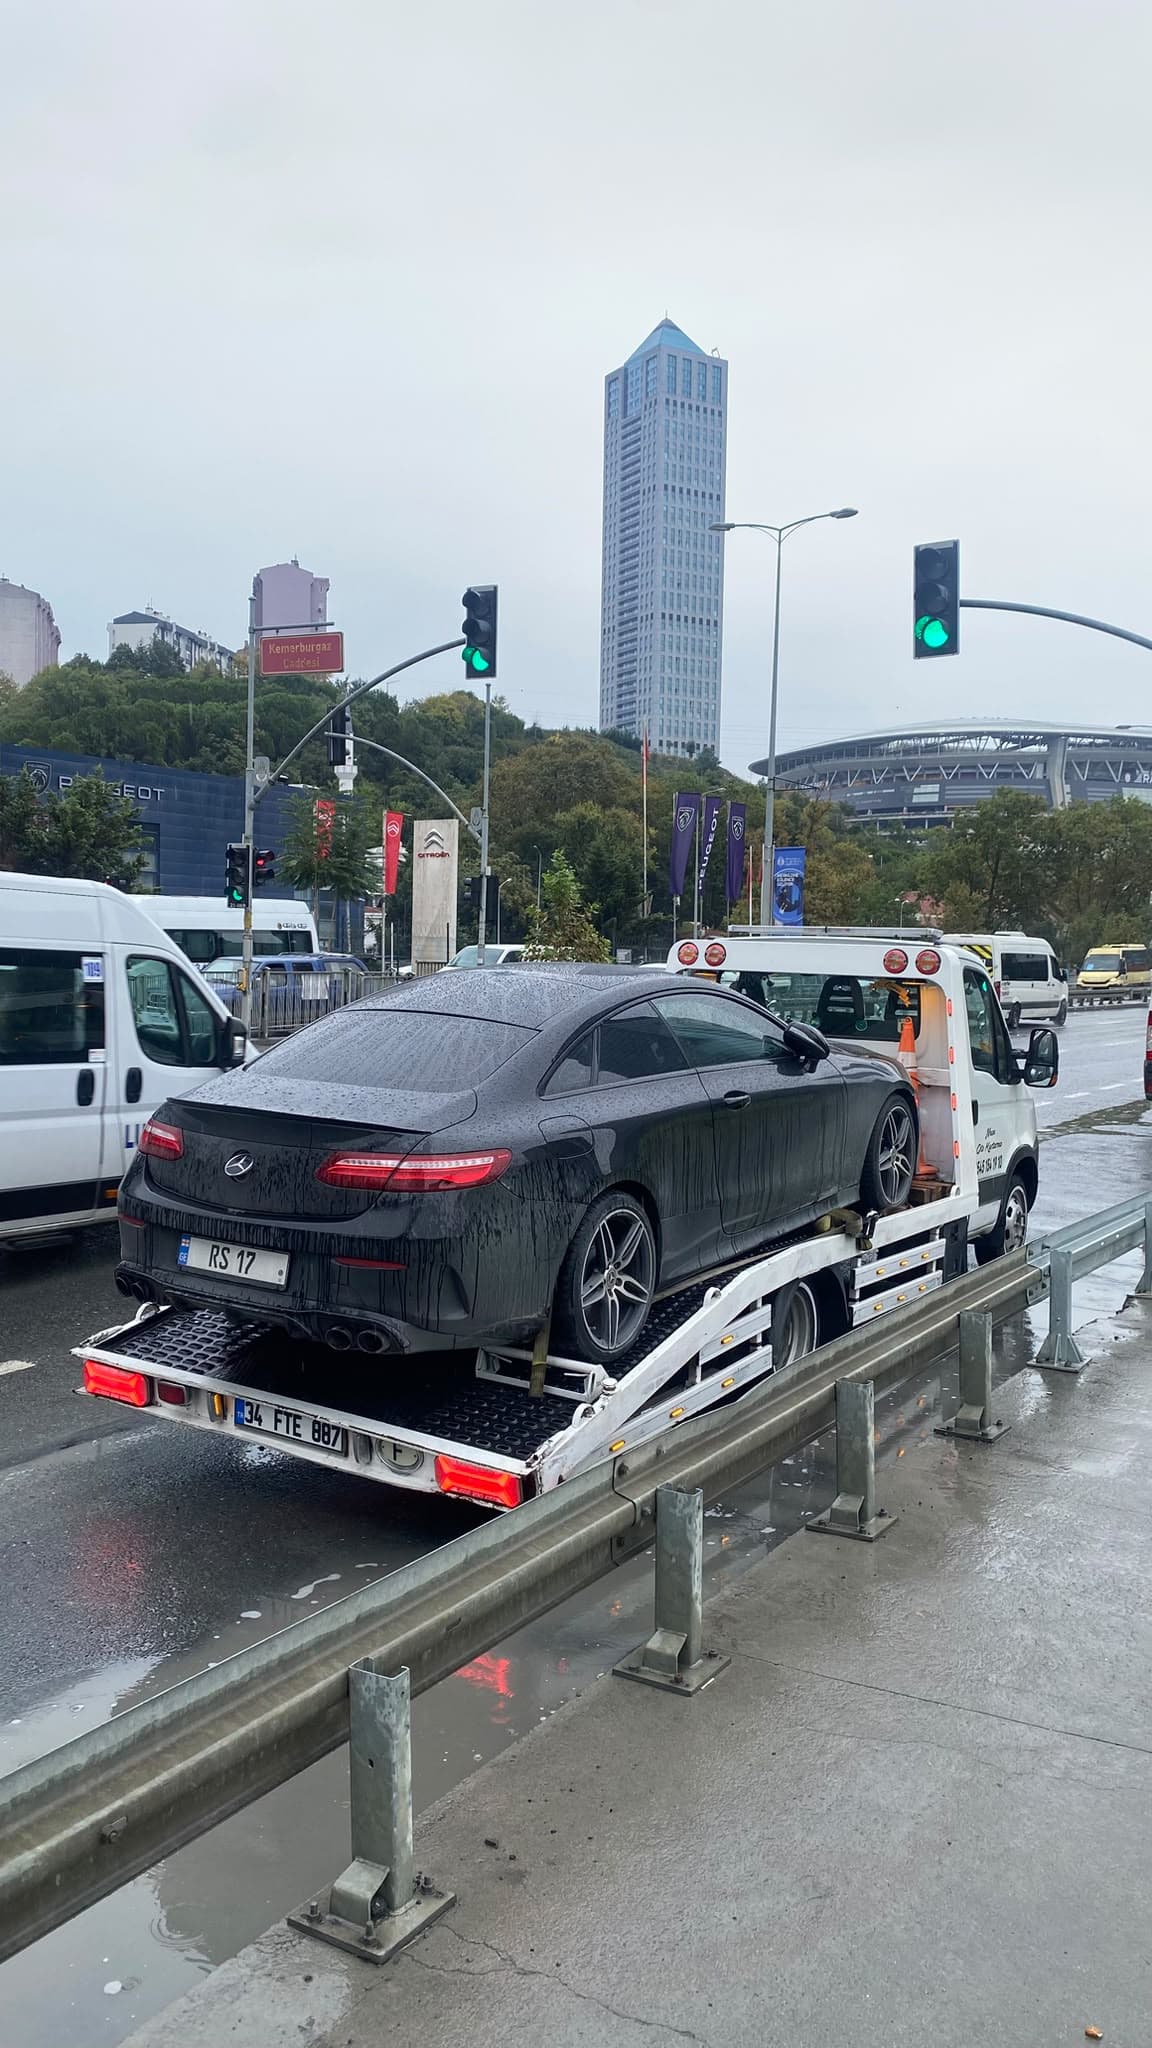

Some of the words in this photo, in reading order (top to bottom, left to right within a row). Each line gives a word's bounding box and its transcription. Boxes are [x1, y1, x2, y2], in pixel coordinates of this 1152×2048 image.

[268, 642, 332, 655] Kemerburgaz
[208, 1244, 231, 1270] RS
[237, 1249, 257, 1275] 17
[245, 1401, 263, 1427] 34
[274, 1409, 302, 1438] FTE
[312, 1420, 341, 1448] 887
